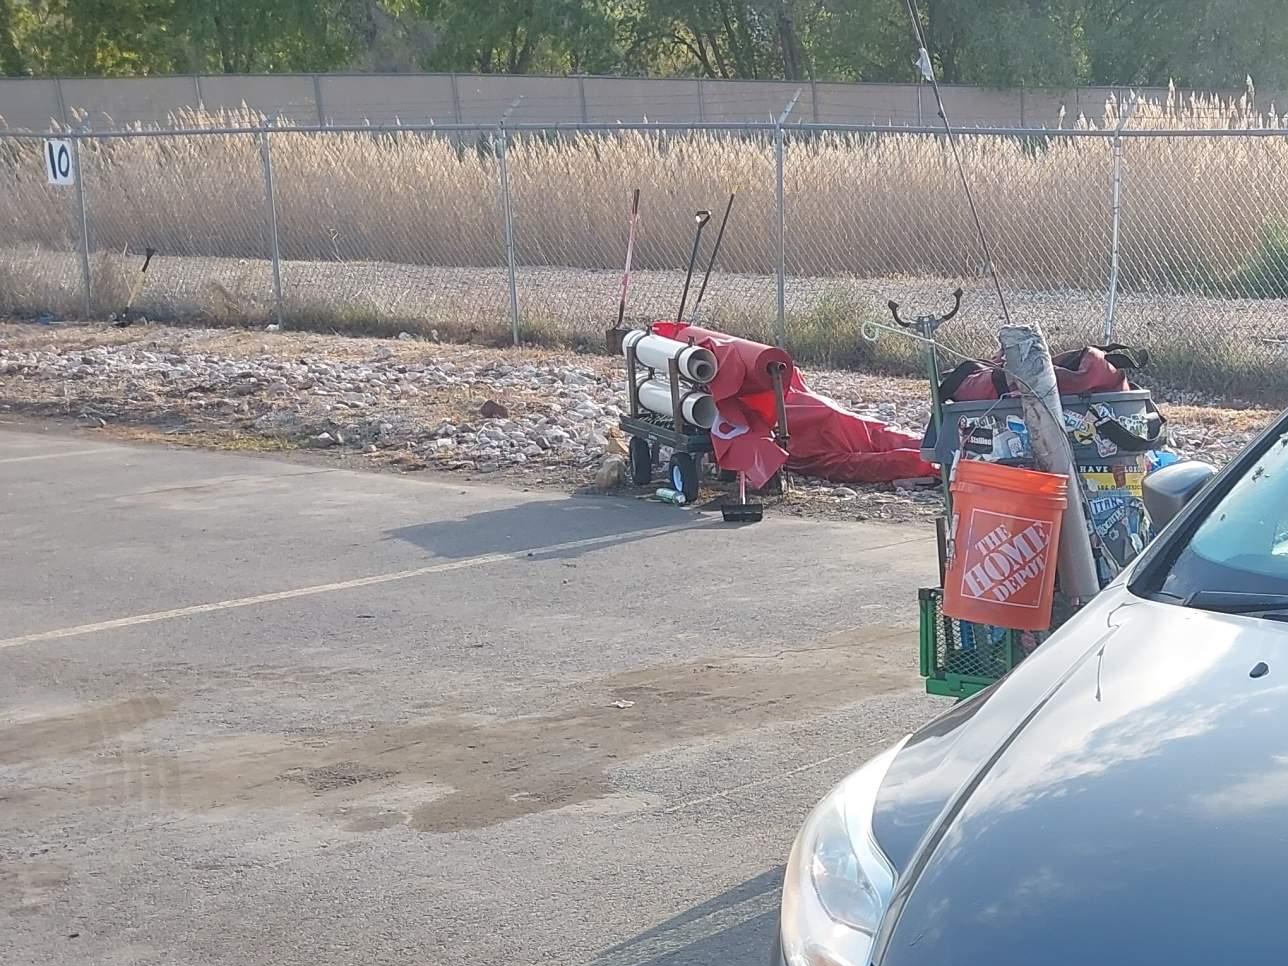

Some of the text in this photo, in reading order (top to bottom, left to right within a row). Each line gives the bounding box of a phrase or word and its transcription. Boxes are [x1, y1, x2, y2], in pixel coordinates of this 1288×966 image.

[48, 142, 70, 180] 10
[964, 521, 1049, 597] HOME
[975, 524, 1012, 556] THE
[992, 554, 1045, 602] DEPOT
